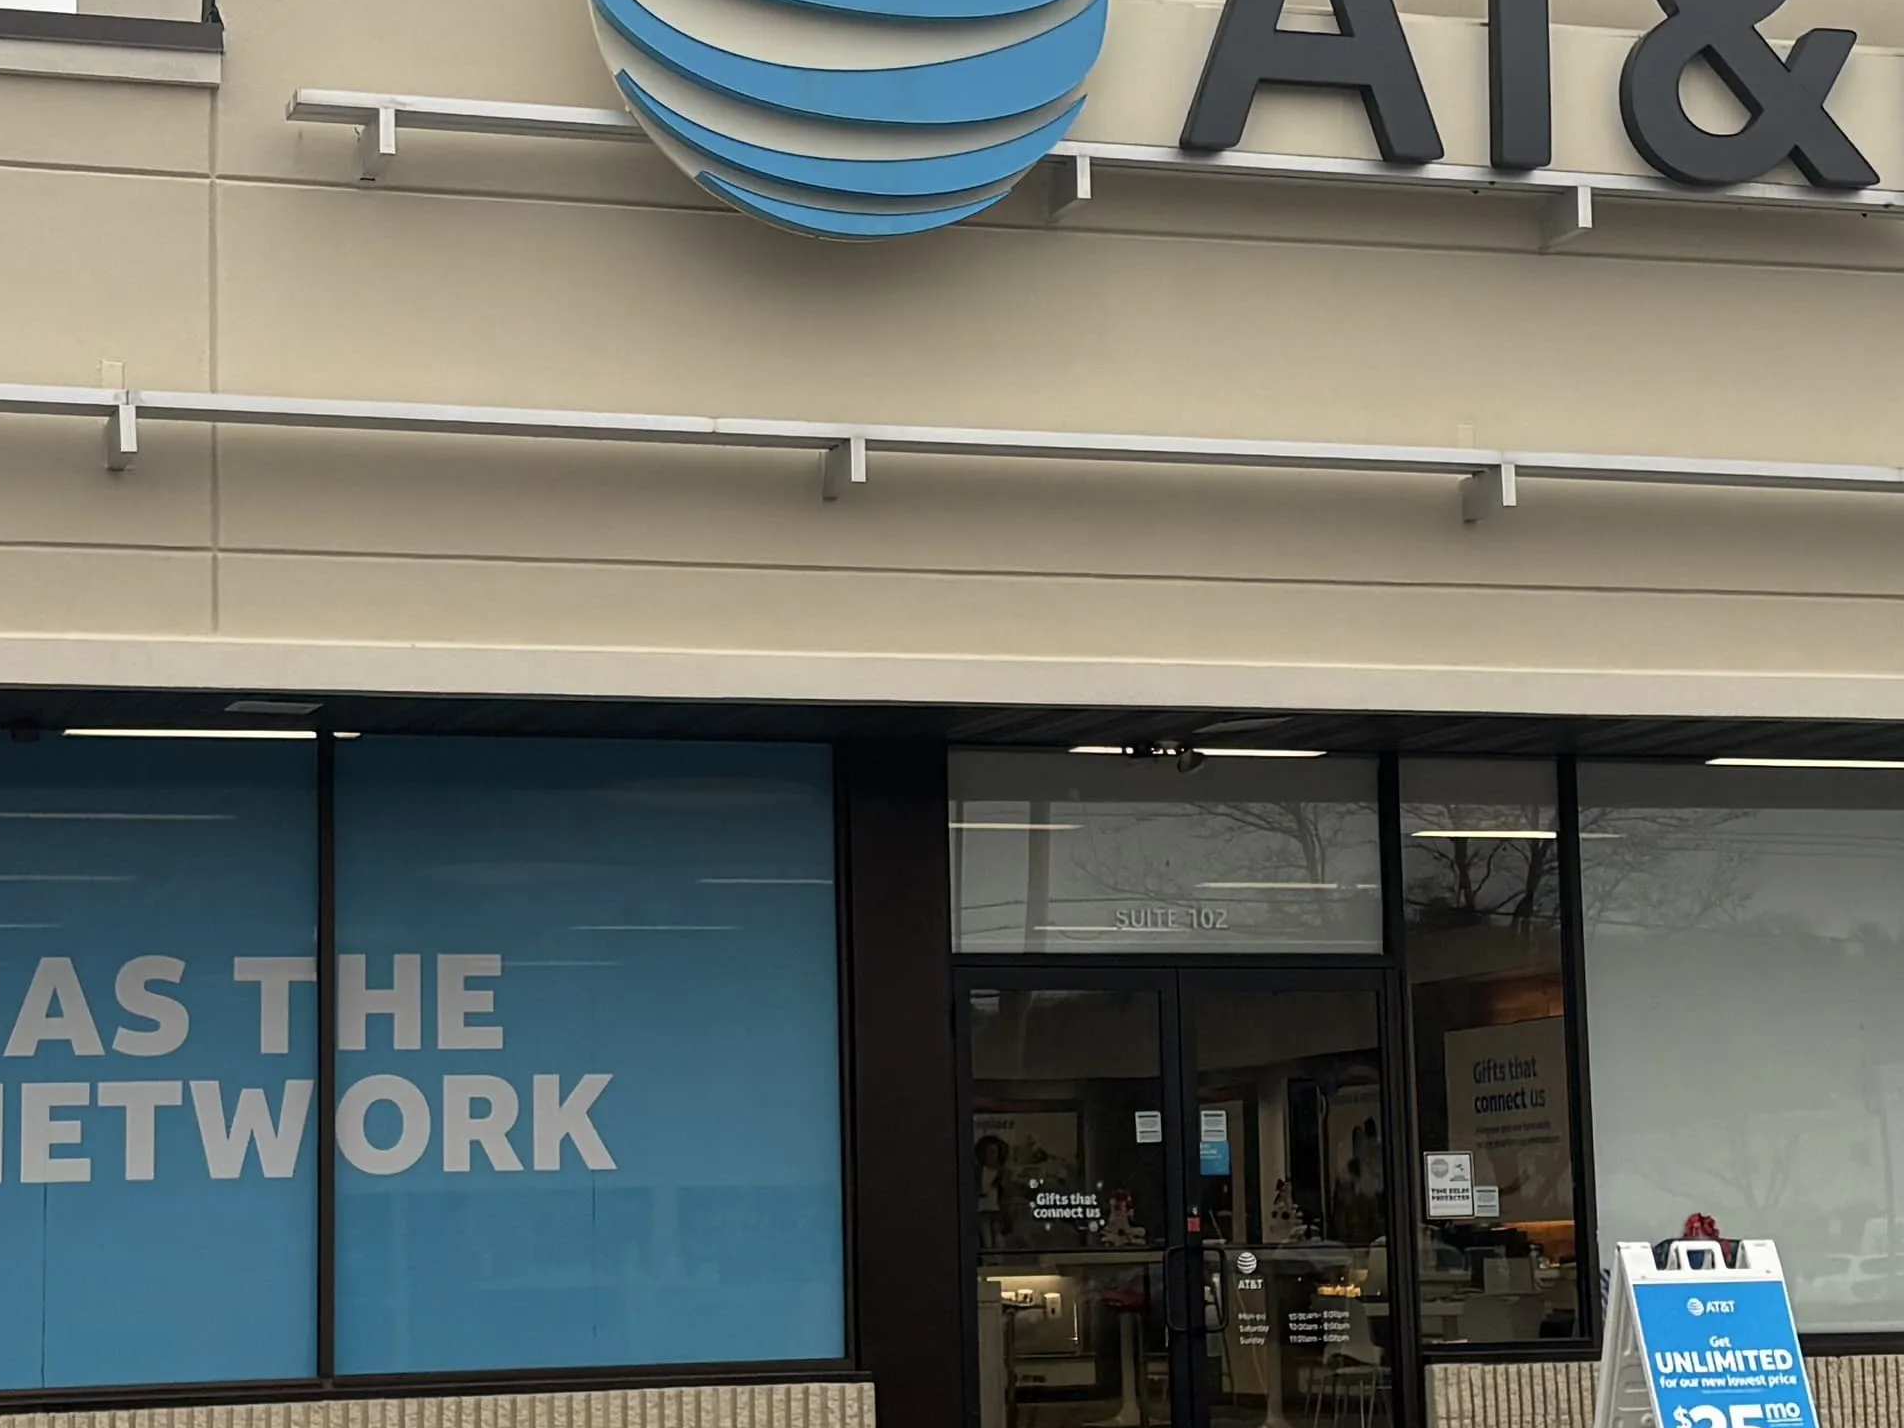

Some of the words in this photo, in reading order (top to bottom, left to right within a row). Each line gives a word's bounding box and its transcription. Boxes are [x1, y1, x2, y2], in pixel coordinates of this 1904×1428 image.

[1116, 908, 1179, 928] SUITE
[1189, 908, 1228, 929] 102
[232, 952, 504, 1054] THE
[1473, 1057, 1506, 1084] Gifts
[1508, 1055, 1537, 1080] that
[1474, 1087, 1527, 1113] connect
[1530, 1088, 1545, 1108] us
[1036, 1193, 1068, 1206] Gifts
[1070, 1193, 1097, 1205] that
[1033, 1206, 1084, 1219] connect
[1086, 1208, 1101, 1219] us
[1238, 1279, 1264, 1289] AT&T
[1706, 1300, 1735, 1314] AT&T
[1239, 1324, 1269, 1333] Saturday
[1239, 1336, 1265, 1345] Sunday
[1709, 1335, 1732, 1348] Get
[1655, 1349, 1793, 1374] UNLIMITED
[1660, 1376, 1677, 1388] for
[1679, 1377, 1698, 1388] our
[1701, 1377, 1725, 1388] new
[1727, 1375, 1766, 1387] lowest
[1768, 1374, 1797, 1388] price
[1765, 1402, 1802, 1419] mo
